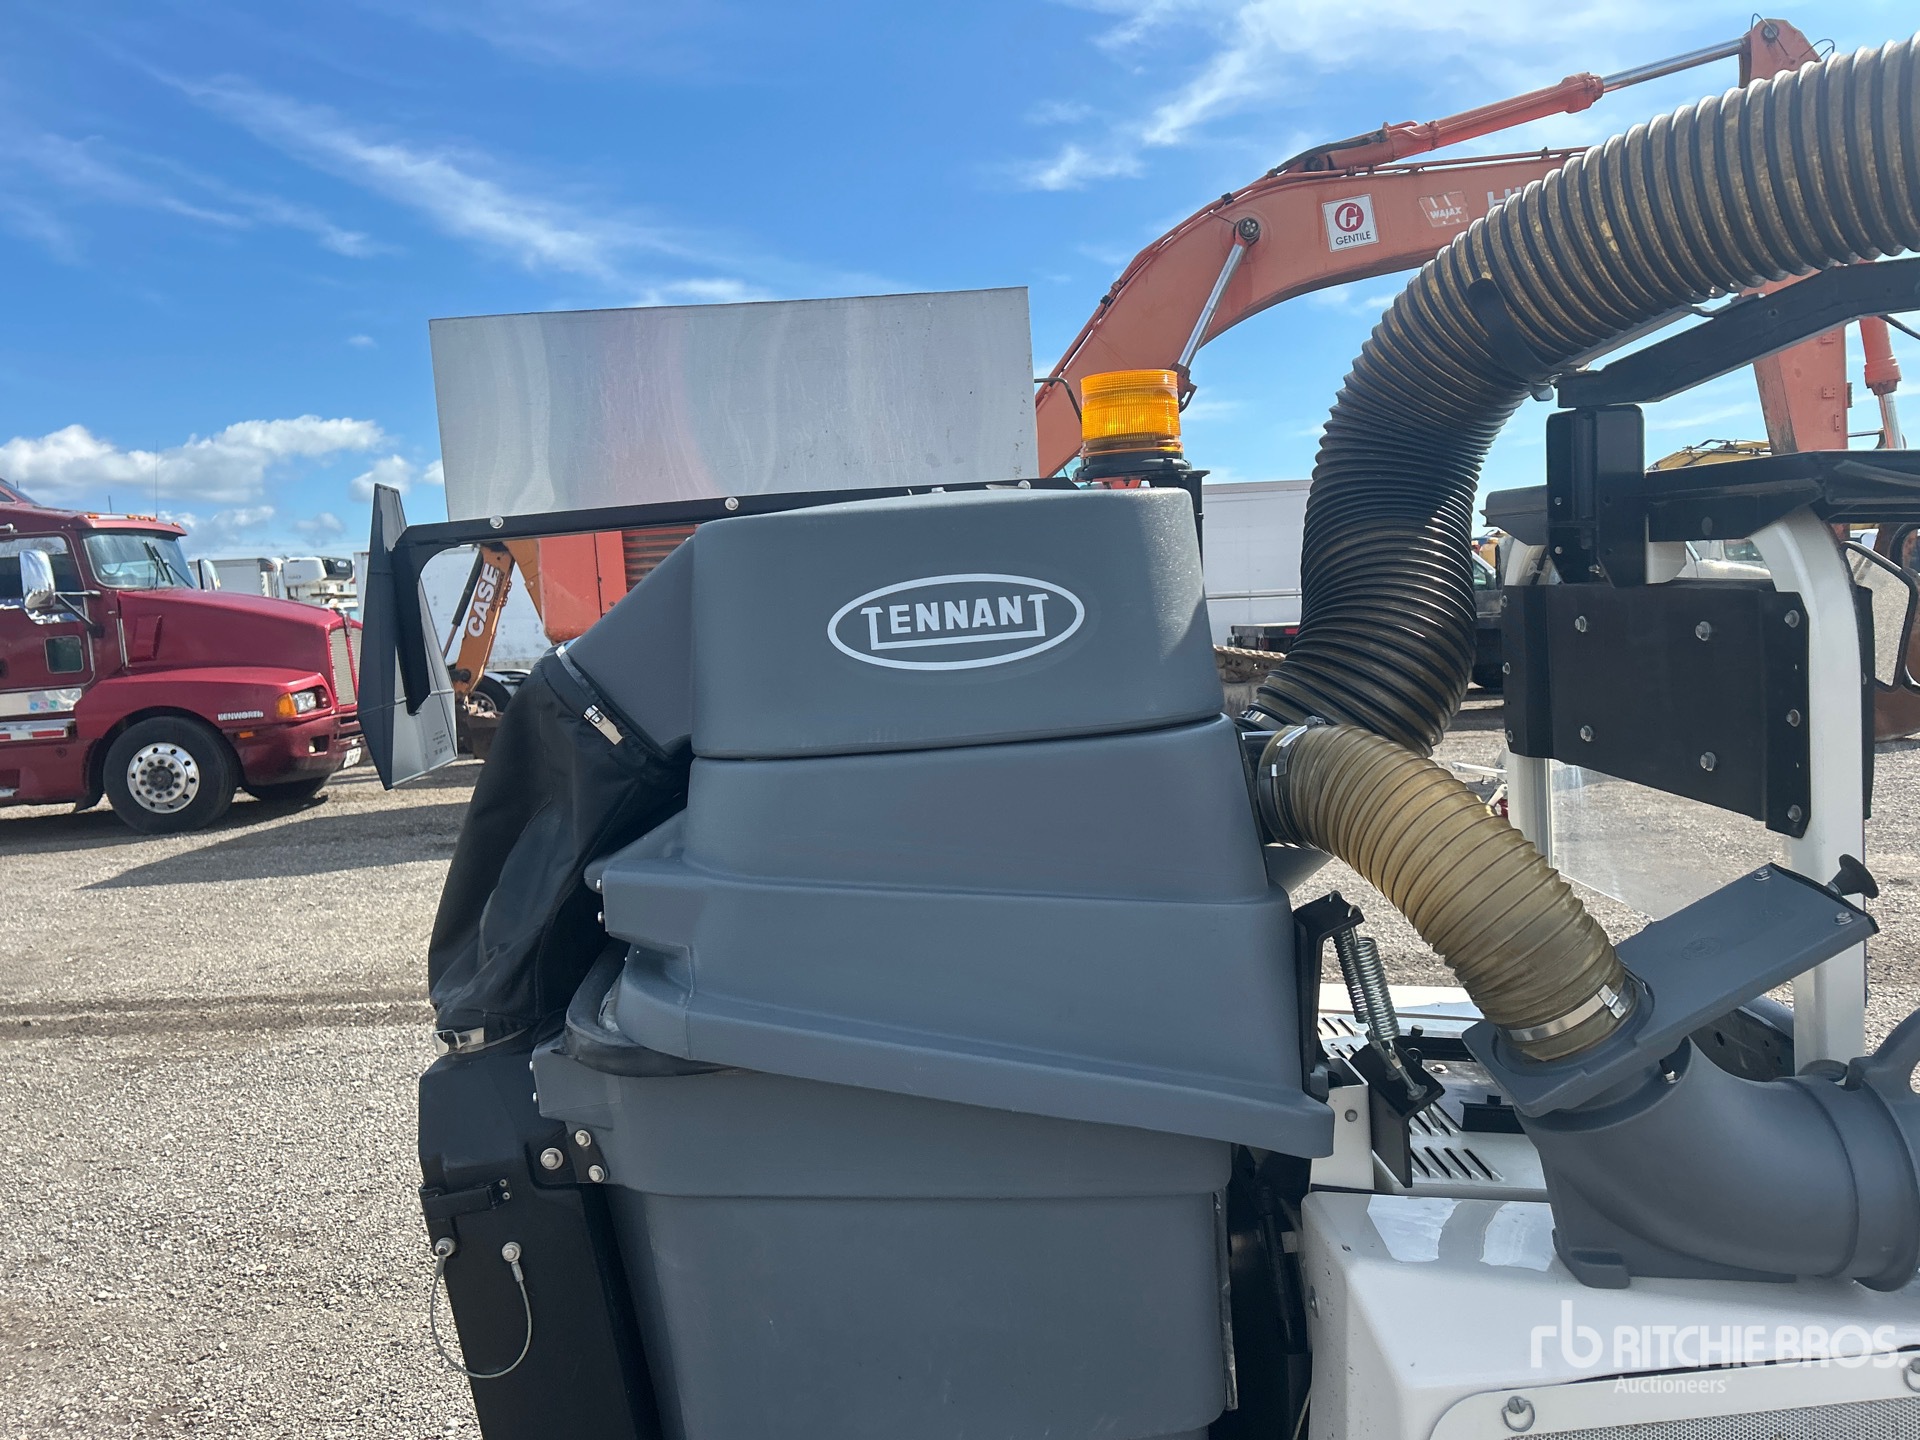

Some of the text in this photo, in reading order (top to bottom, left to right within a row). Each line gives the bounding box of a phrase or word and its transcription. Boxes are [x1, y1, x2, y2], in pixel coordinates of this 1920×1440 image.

[1430, 206, 1463, 219] WAJAX
[1335, 230, 1372, 246] GENTILE
[467, 562, 500, 637] CASE
[860, 593, 1049, 650] TENNANT
